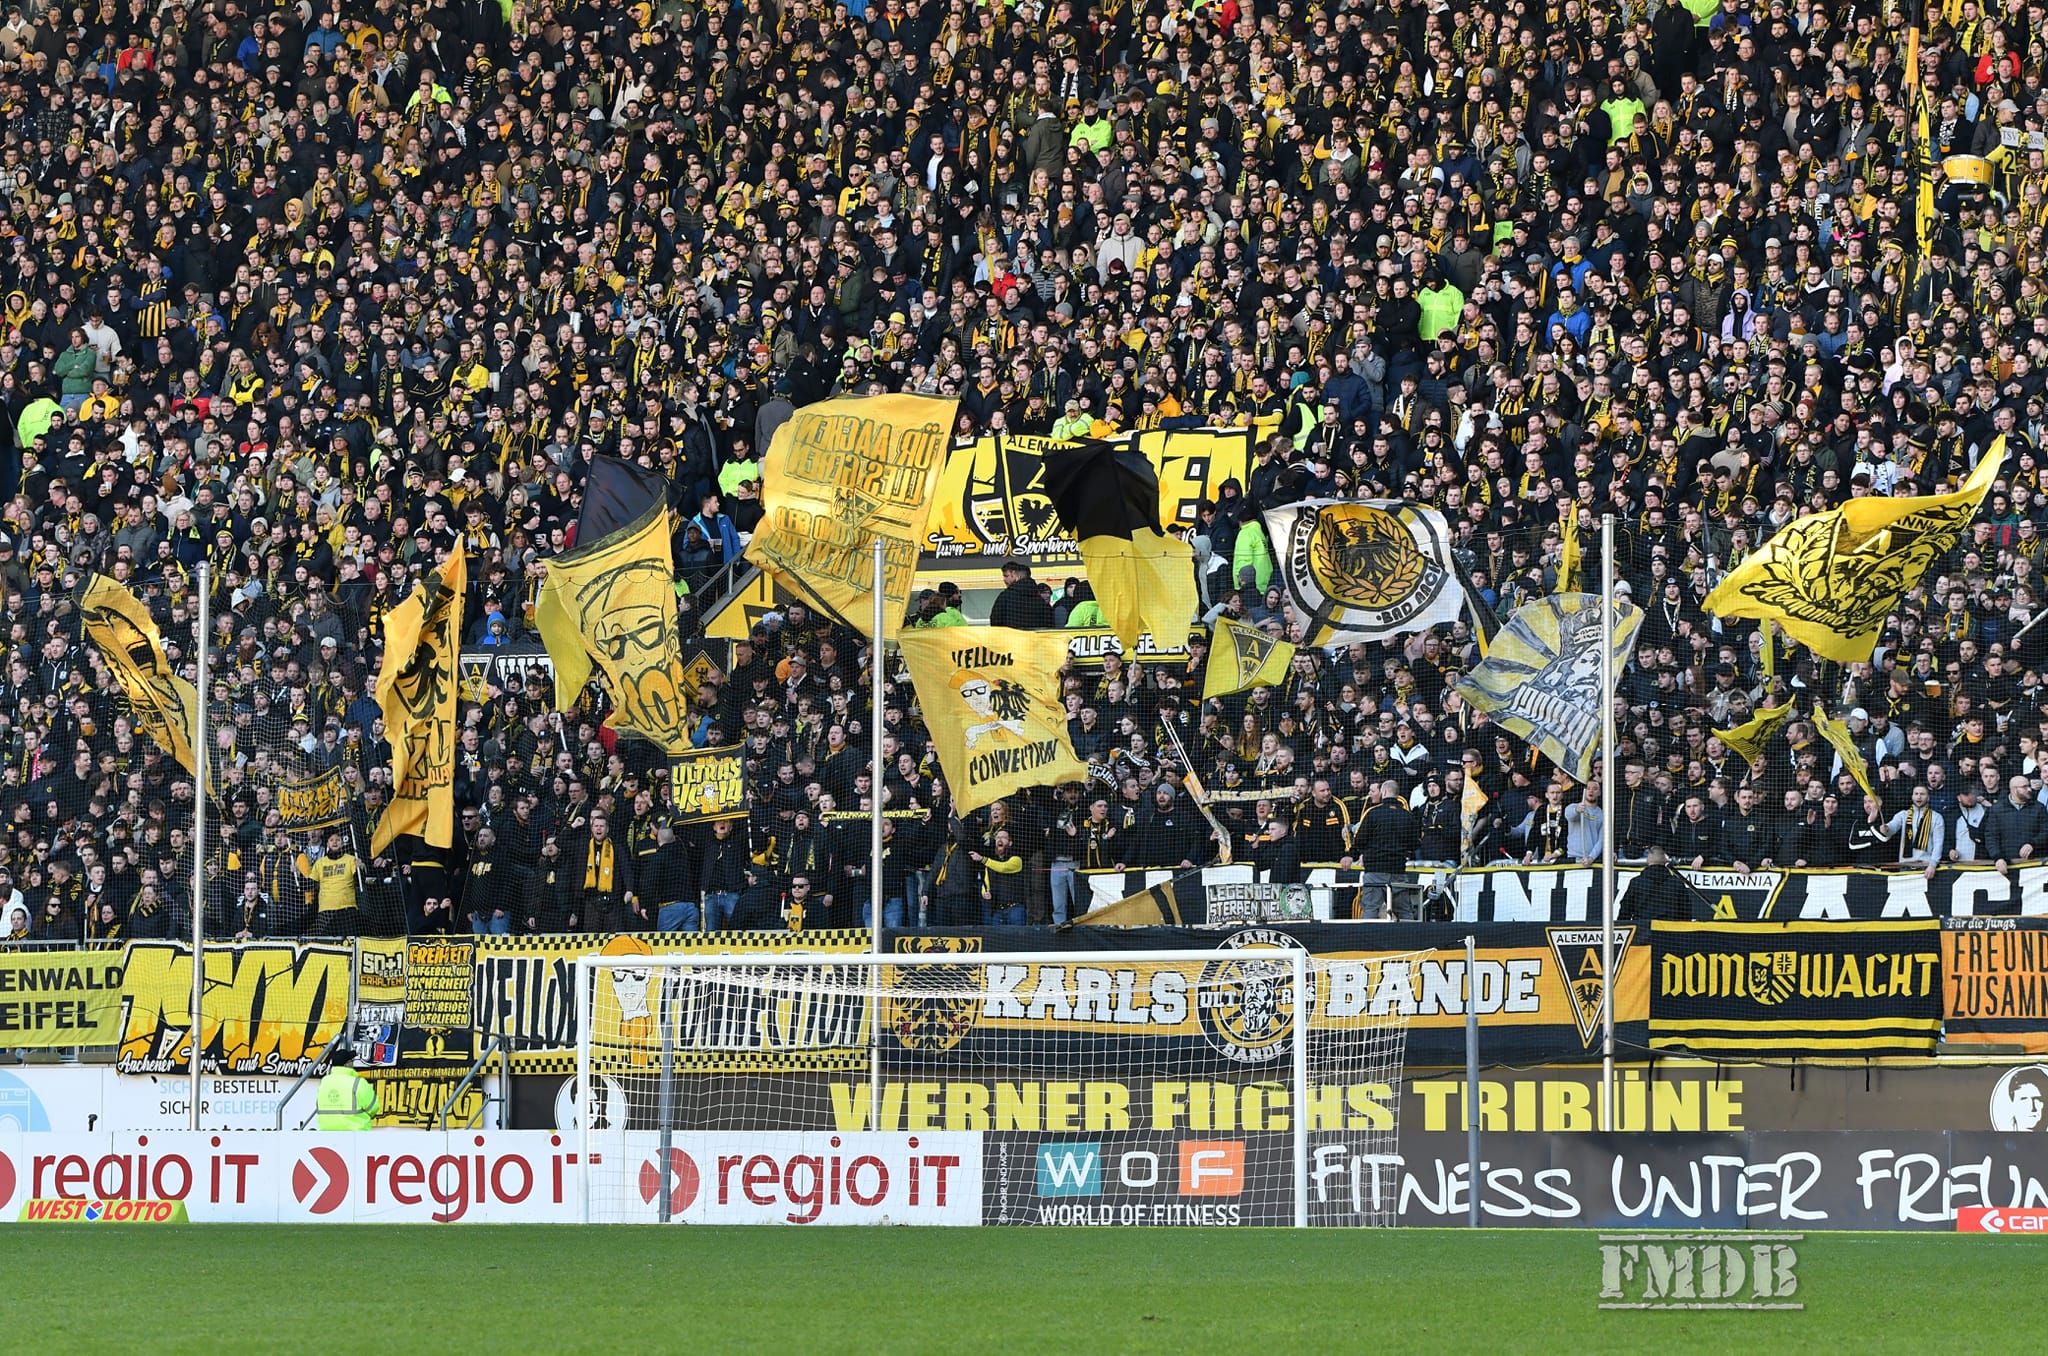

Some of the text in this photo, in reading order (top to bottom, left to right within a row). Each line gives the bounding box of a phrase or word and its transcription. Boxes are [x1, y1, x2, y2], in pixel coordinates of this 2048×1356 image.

[2004, 151, 2015, 173] 2
[983, 534, 1008, 555] und
[1012, 533, 1079, 556] Sportvere
[1382, 602, 1413, 624] BAD
[672, 757, 742, 785] ULTRAS
[1088, 765, 1118, 791] ACHEN
[1228, 930, 1292, 950] KARLS
[409, 945, 471, 965] FREIHEIT
[1578, 947, 1603, 976] A
[1661, 952, 1940, 999] DOM WACHT
[982, 959, 1542, 1025] KARLS BANDE
[159, 1080, 281, 1094] SICHR BESTELLT.
[159, 1101, 209, 1115] SICHR
[830, 1070, 1745, 1132] WERNER FUCHS TRIBÜNE
[32, 1135, 260, 1204] regio iT
[366, 1135, 534, 1222] regio
[717, 1136, 960, 1223] regio iT
[1311, 1145, 1582, 1218] FITNESS
[1611, 1151, 1829, 1220] UNTER
[26, 1200, 173, 1222] WEST LOTTO
[1039, 1204, 1241, 1226] WORLD OF FITNESS
